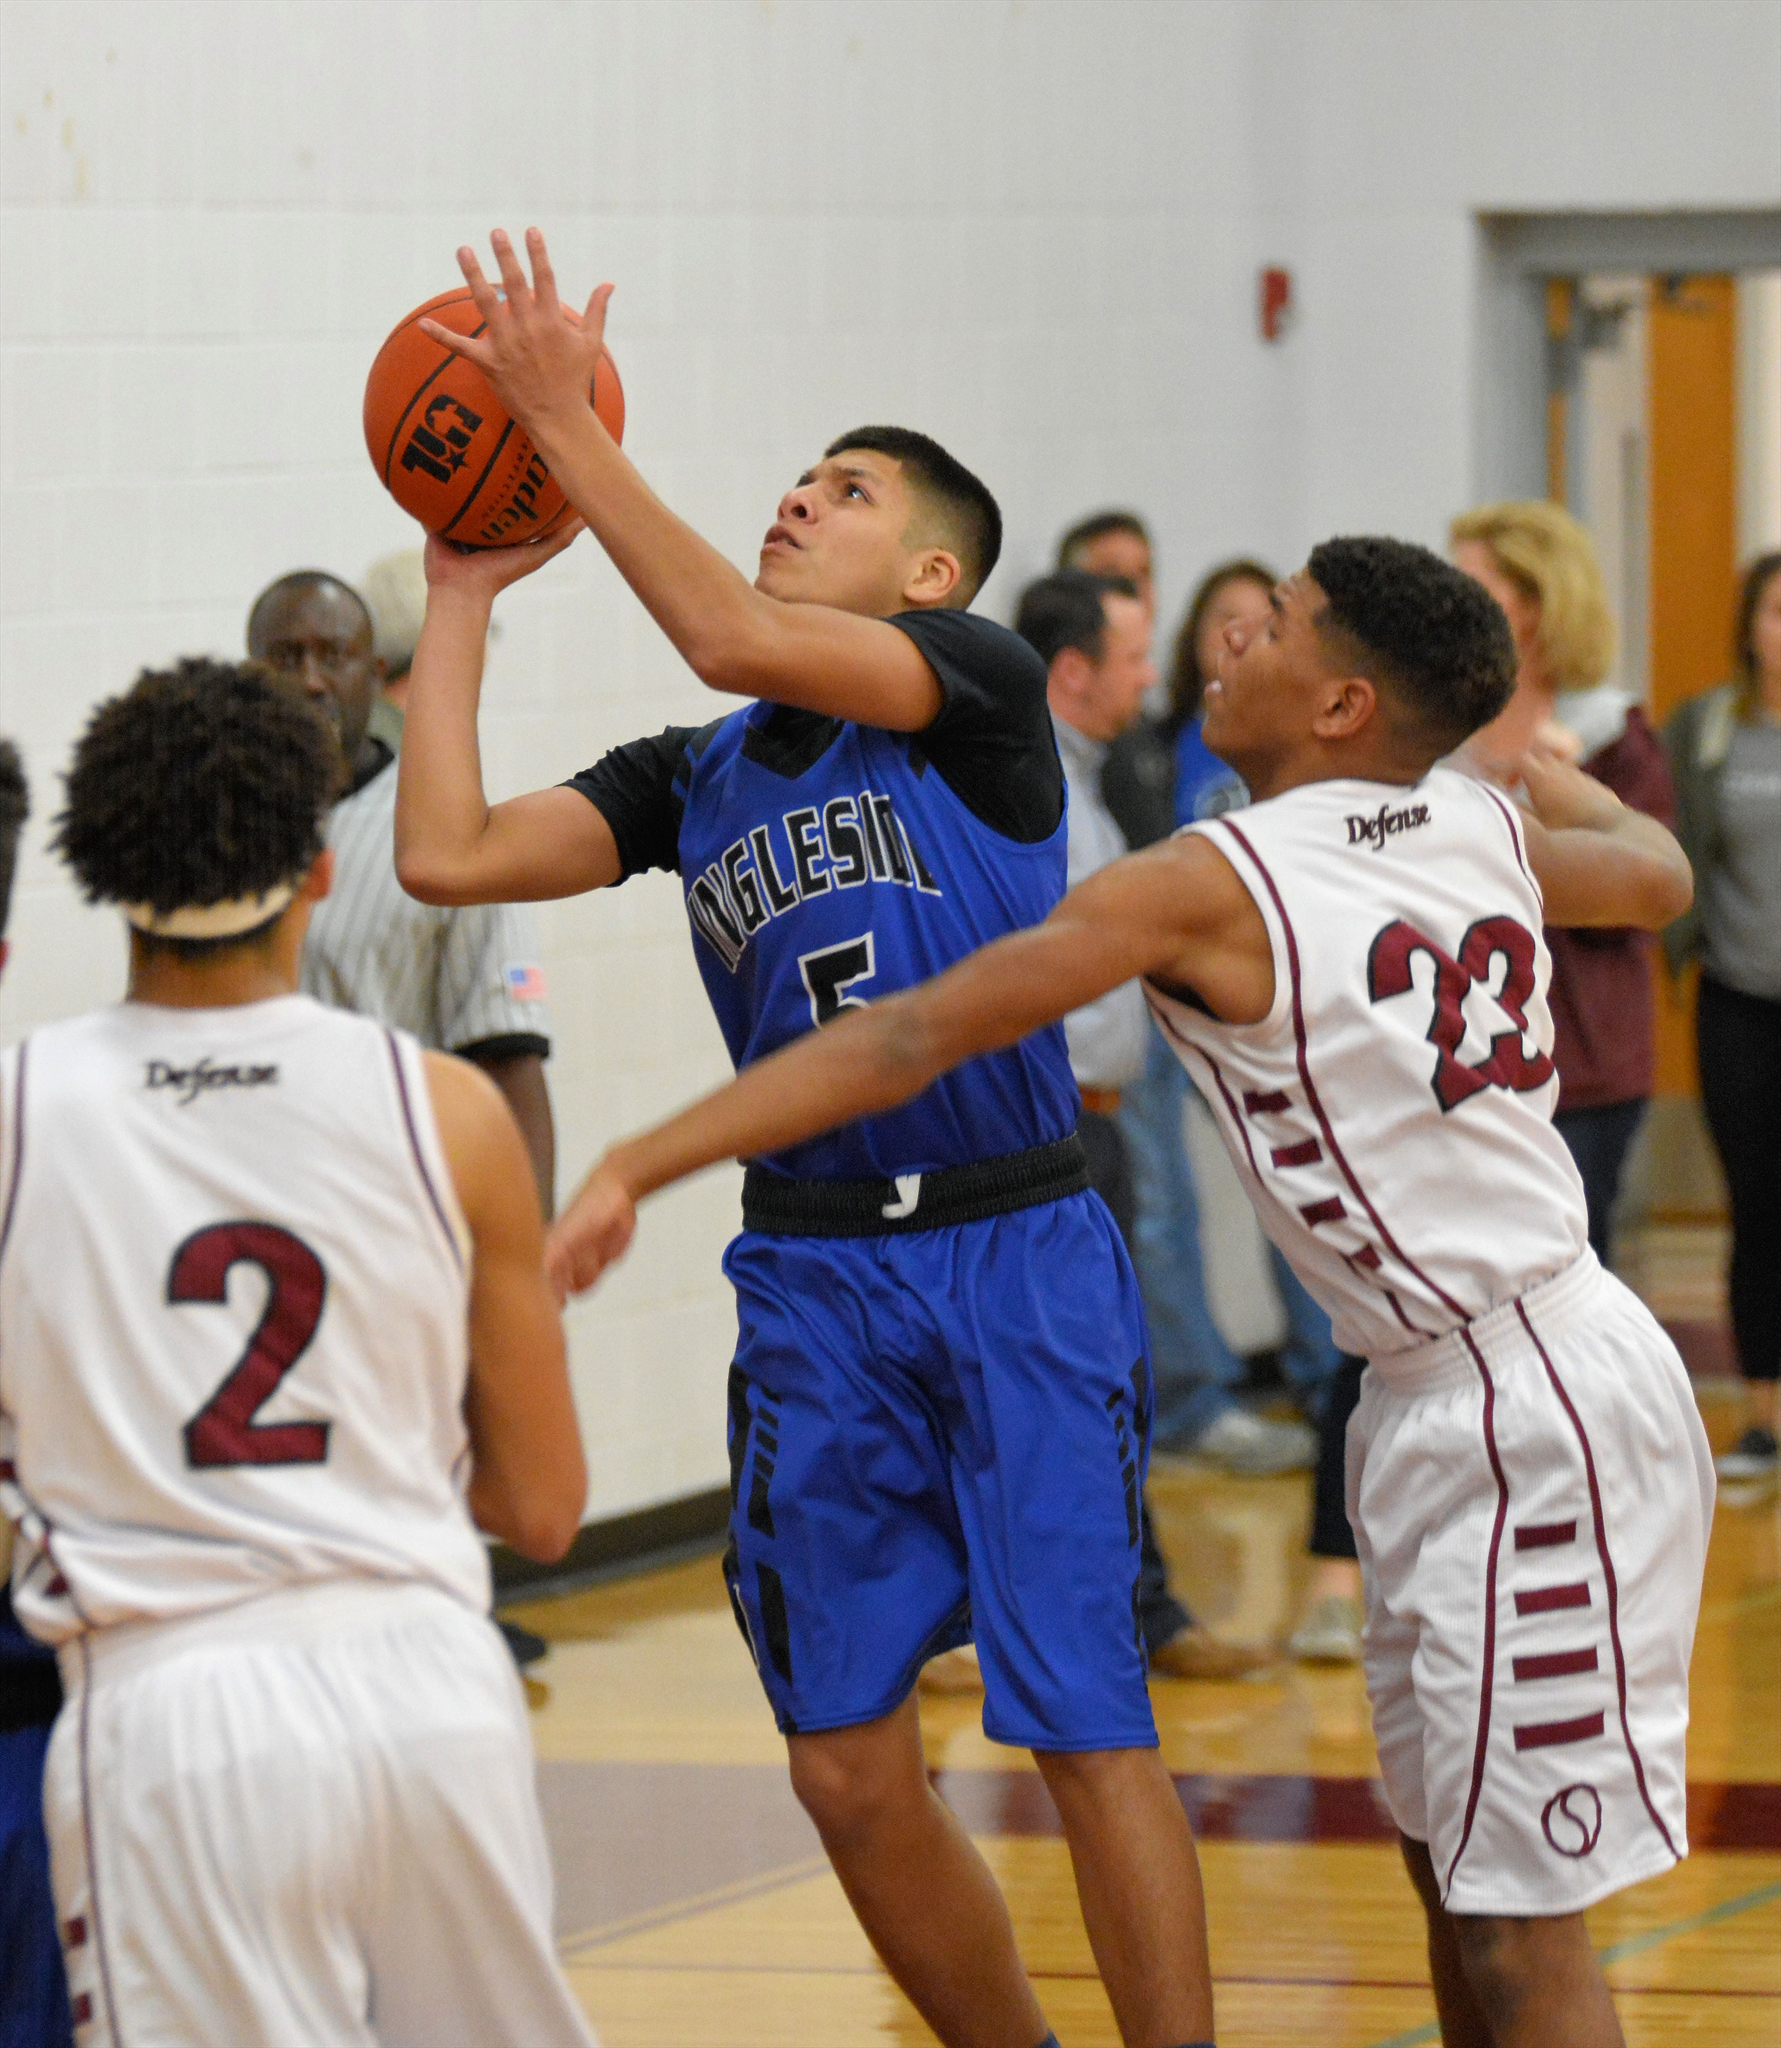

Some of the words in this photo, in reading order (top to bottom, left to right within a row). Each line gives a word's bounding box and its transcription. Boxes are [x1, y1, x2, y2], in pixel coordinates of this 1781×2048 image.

[401, 394, 483, 484] UIL
[480, 452, 549, 540] aden
[1345, 803, 1432, 852] Defense
[1366, 914, 1556, 1115] 23
[144, 1057, 279, 1106] Defense
[165, 1219, 332, 1471] 2
